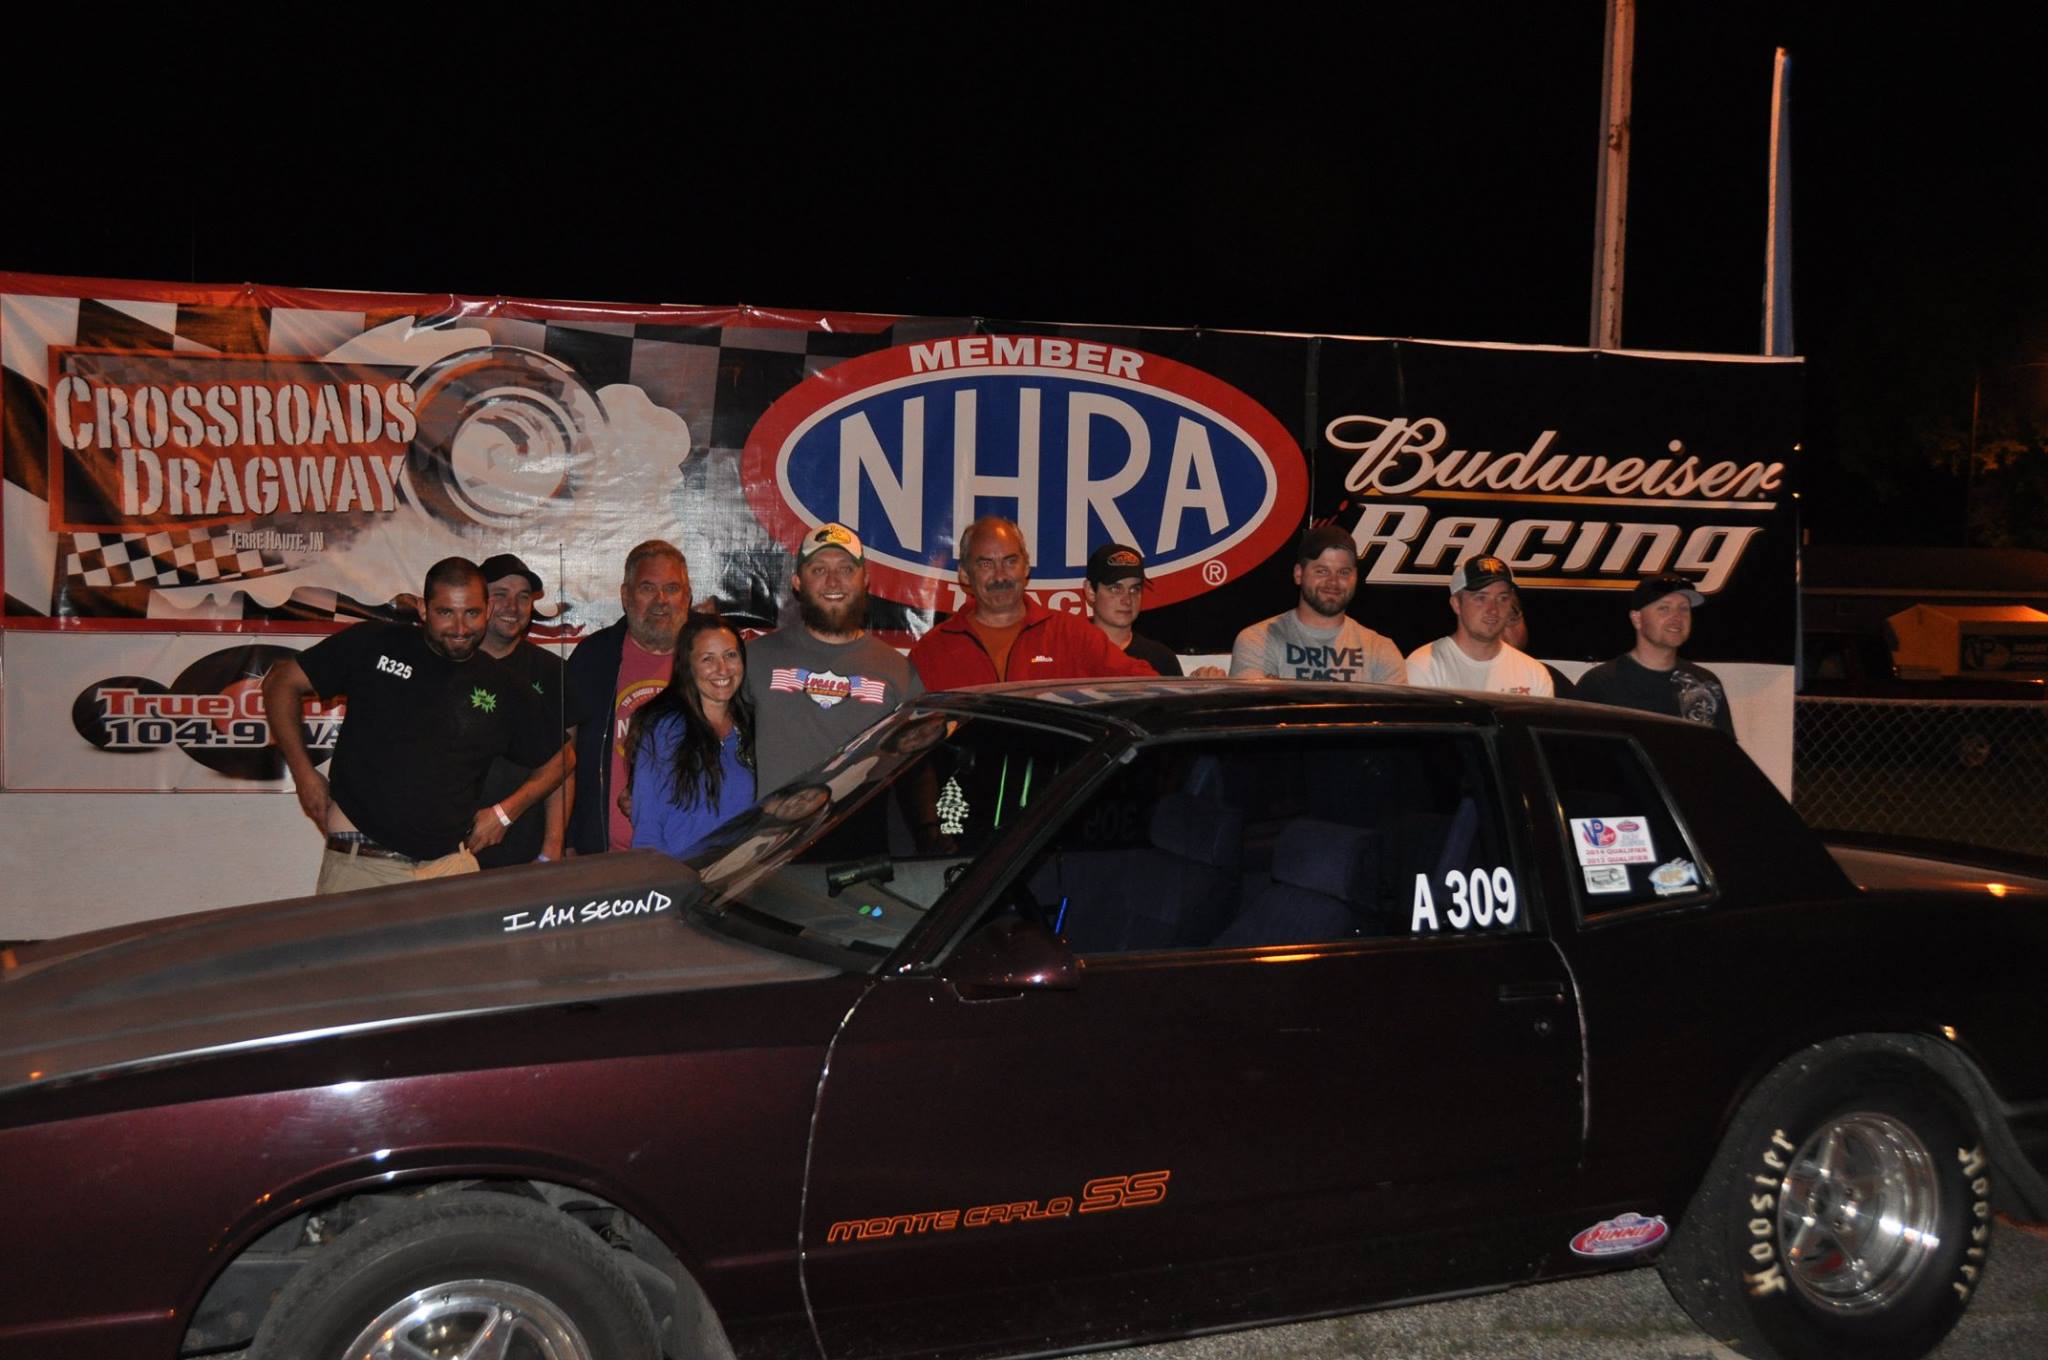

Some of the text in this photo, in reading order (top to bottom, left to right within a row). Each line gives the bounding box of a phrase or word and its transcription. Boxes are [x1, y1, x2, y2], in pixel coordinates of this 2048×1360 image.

[909, 337, 1144, 381] MEMBER
[54, 376, 418, 450] CROSSROADS
[838, 387, 1230, 568] NHRA
[1325, 414, 1786, 498] Budweiser
[120, 449, 407, 516] DRAGWAY
[226, 529, 264, 550] TERRE
[308, 532, 324, 551] IN
[376, 655, 413, 680] R325
[1286, 642, 1364, 668] DRIVE
[97, 689, 234, 718] True
[104, 719, 270, 748] 104.9
[502, 890, 672, 932] I AM SECOND
[1411, 865, 1517, 933] A 309
[826, 1170, 1171, 1243] MONTE CARLO SS
